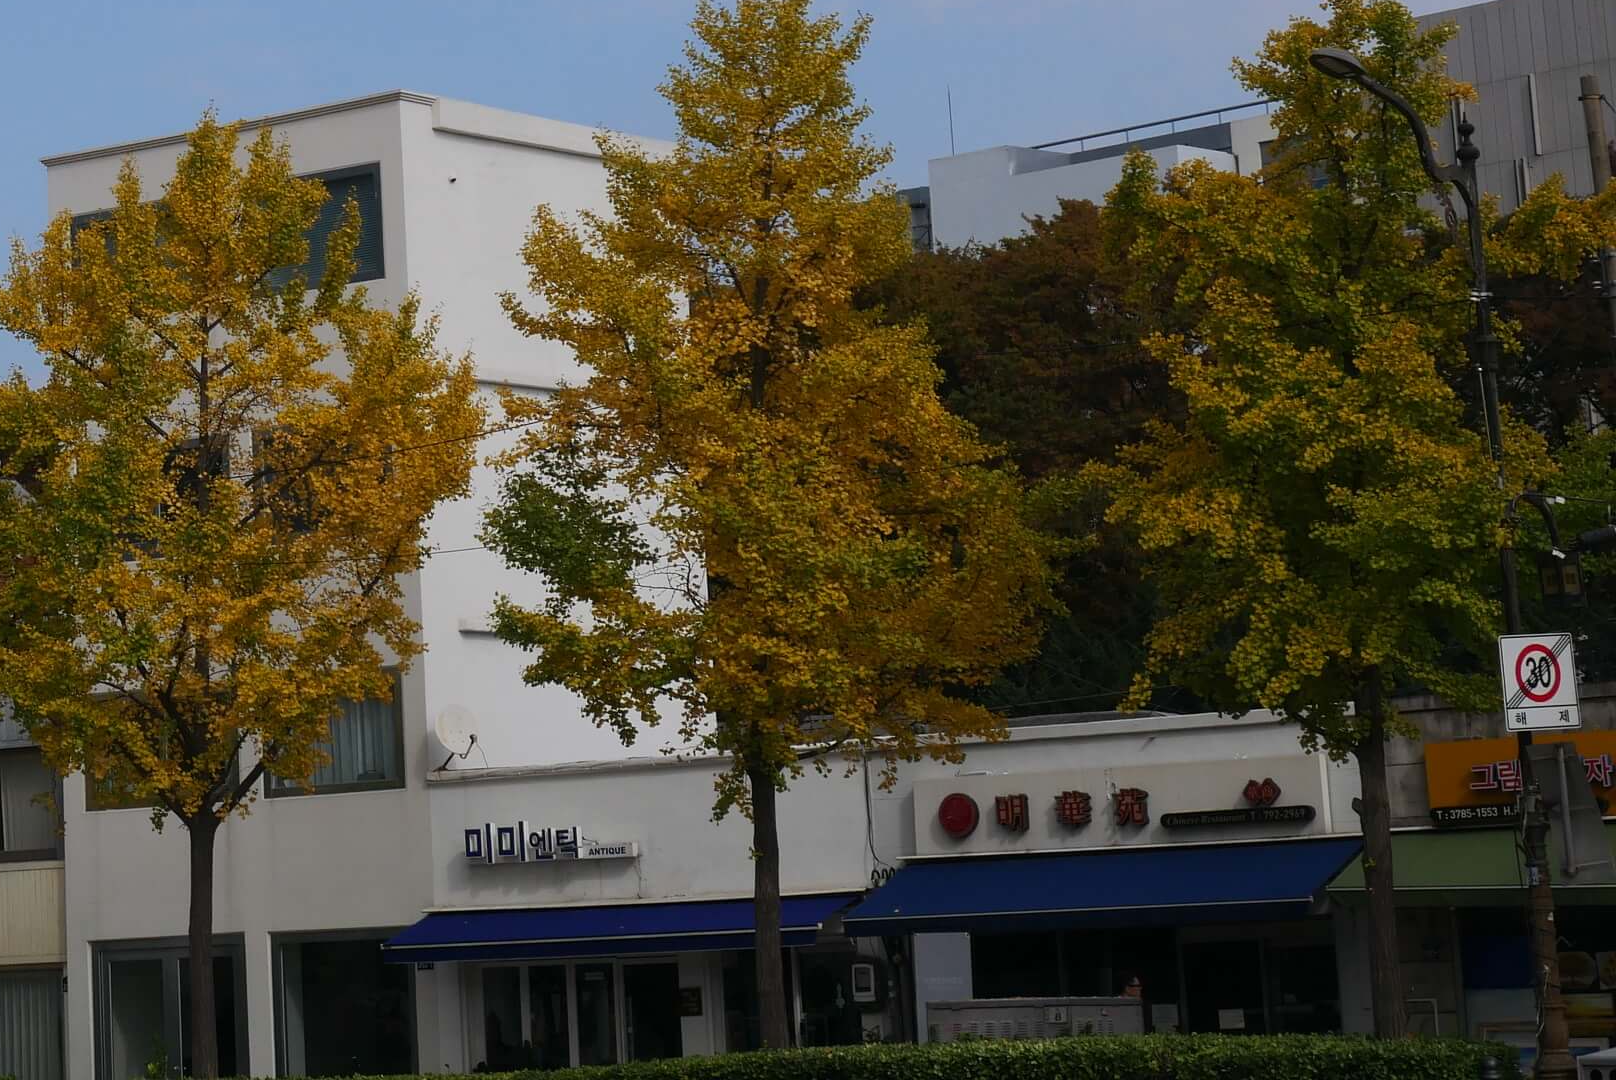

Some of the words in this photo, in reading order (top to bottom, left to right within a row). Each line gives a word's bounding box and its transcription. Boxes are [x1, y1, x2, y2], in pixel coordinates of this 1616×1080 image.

[1526, 656, 1551, 688] 30
[465, 820, 580, 864] 미미엔틱
[588, 846, 626, 857] ANTIQUE
